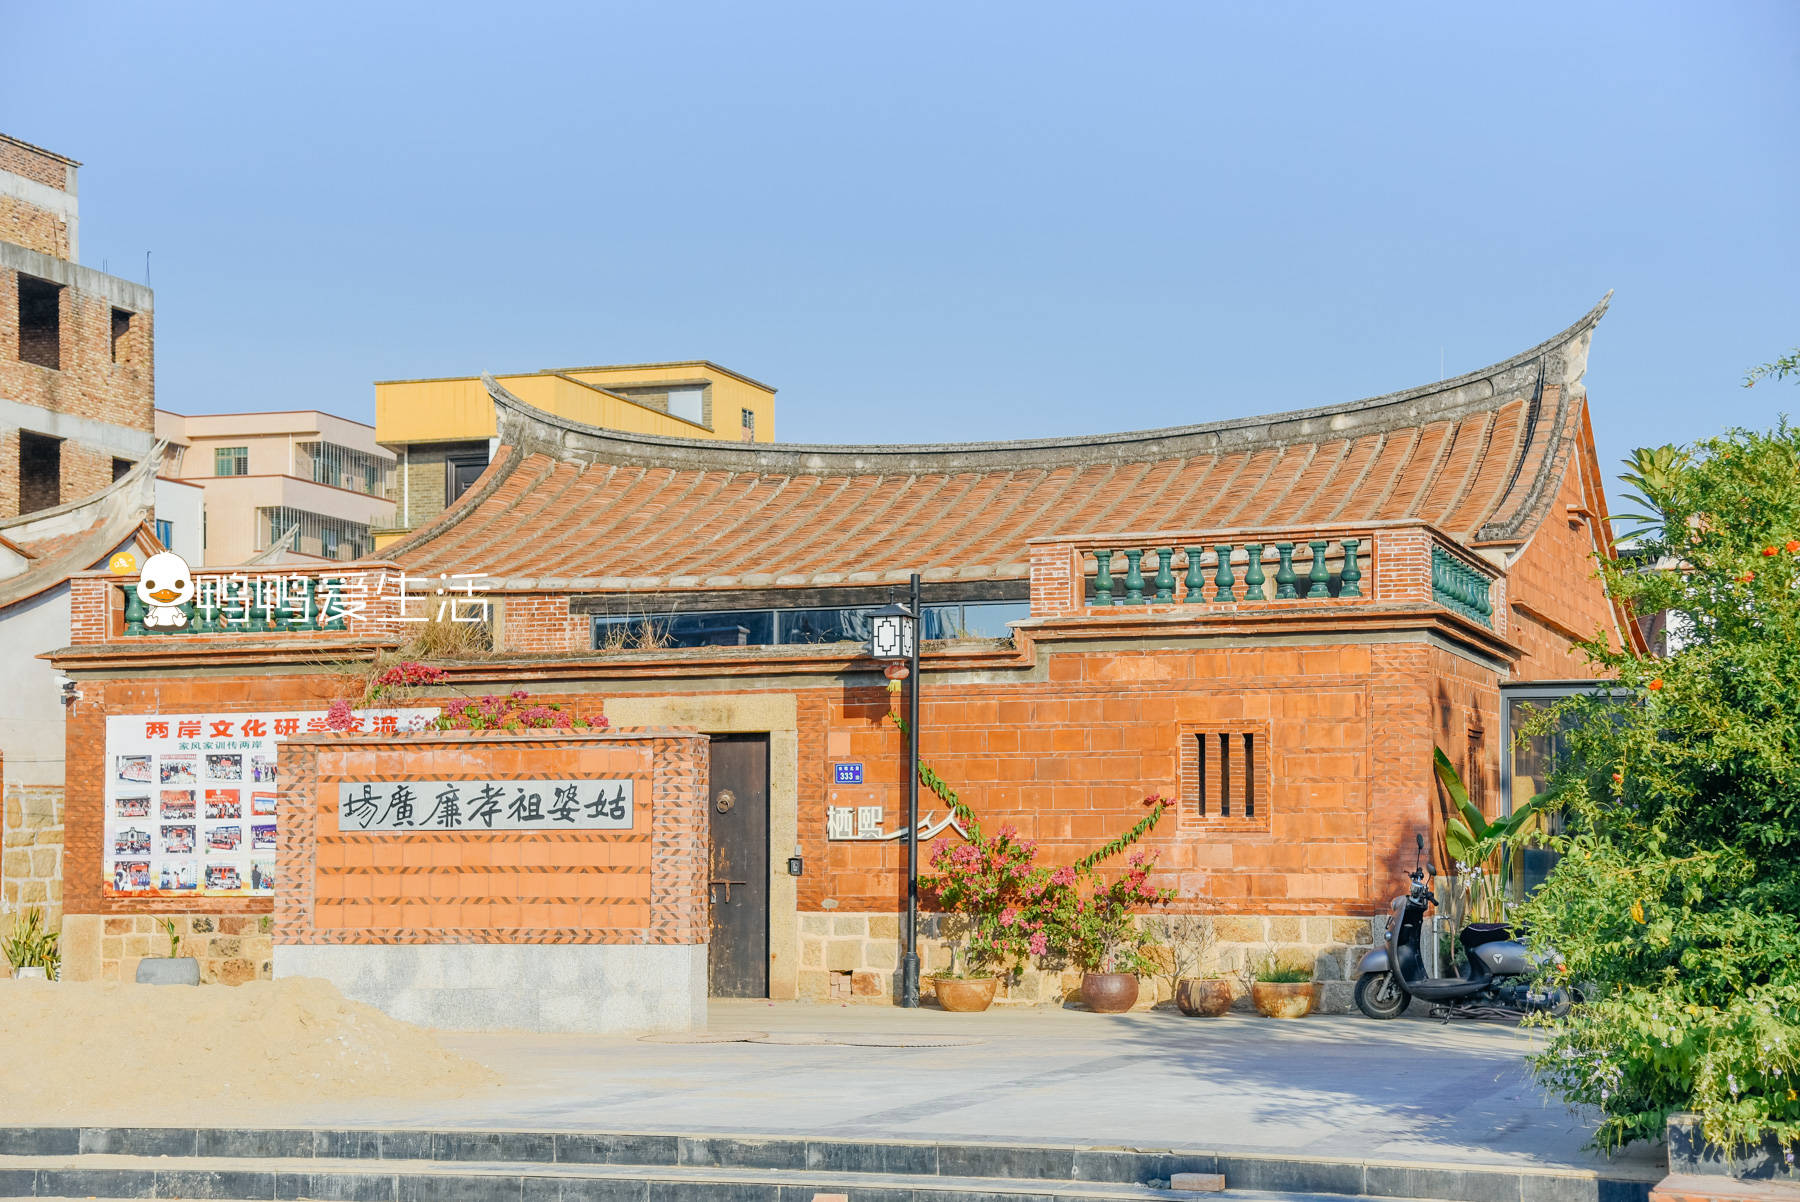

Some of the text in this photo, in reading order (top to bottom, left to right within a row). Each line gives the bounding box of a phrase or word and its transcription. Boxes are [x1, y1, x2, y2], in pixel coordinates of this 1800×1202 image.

[178, 740, 262, 750] 家风家训传两岸
